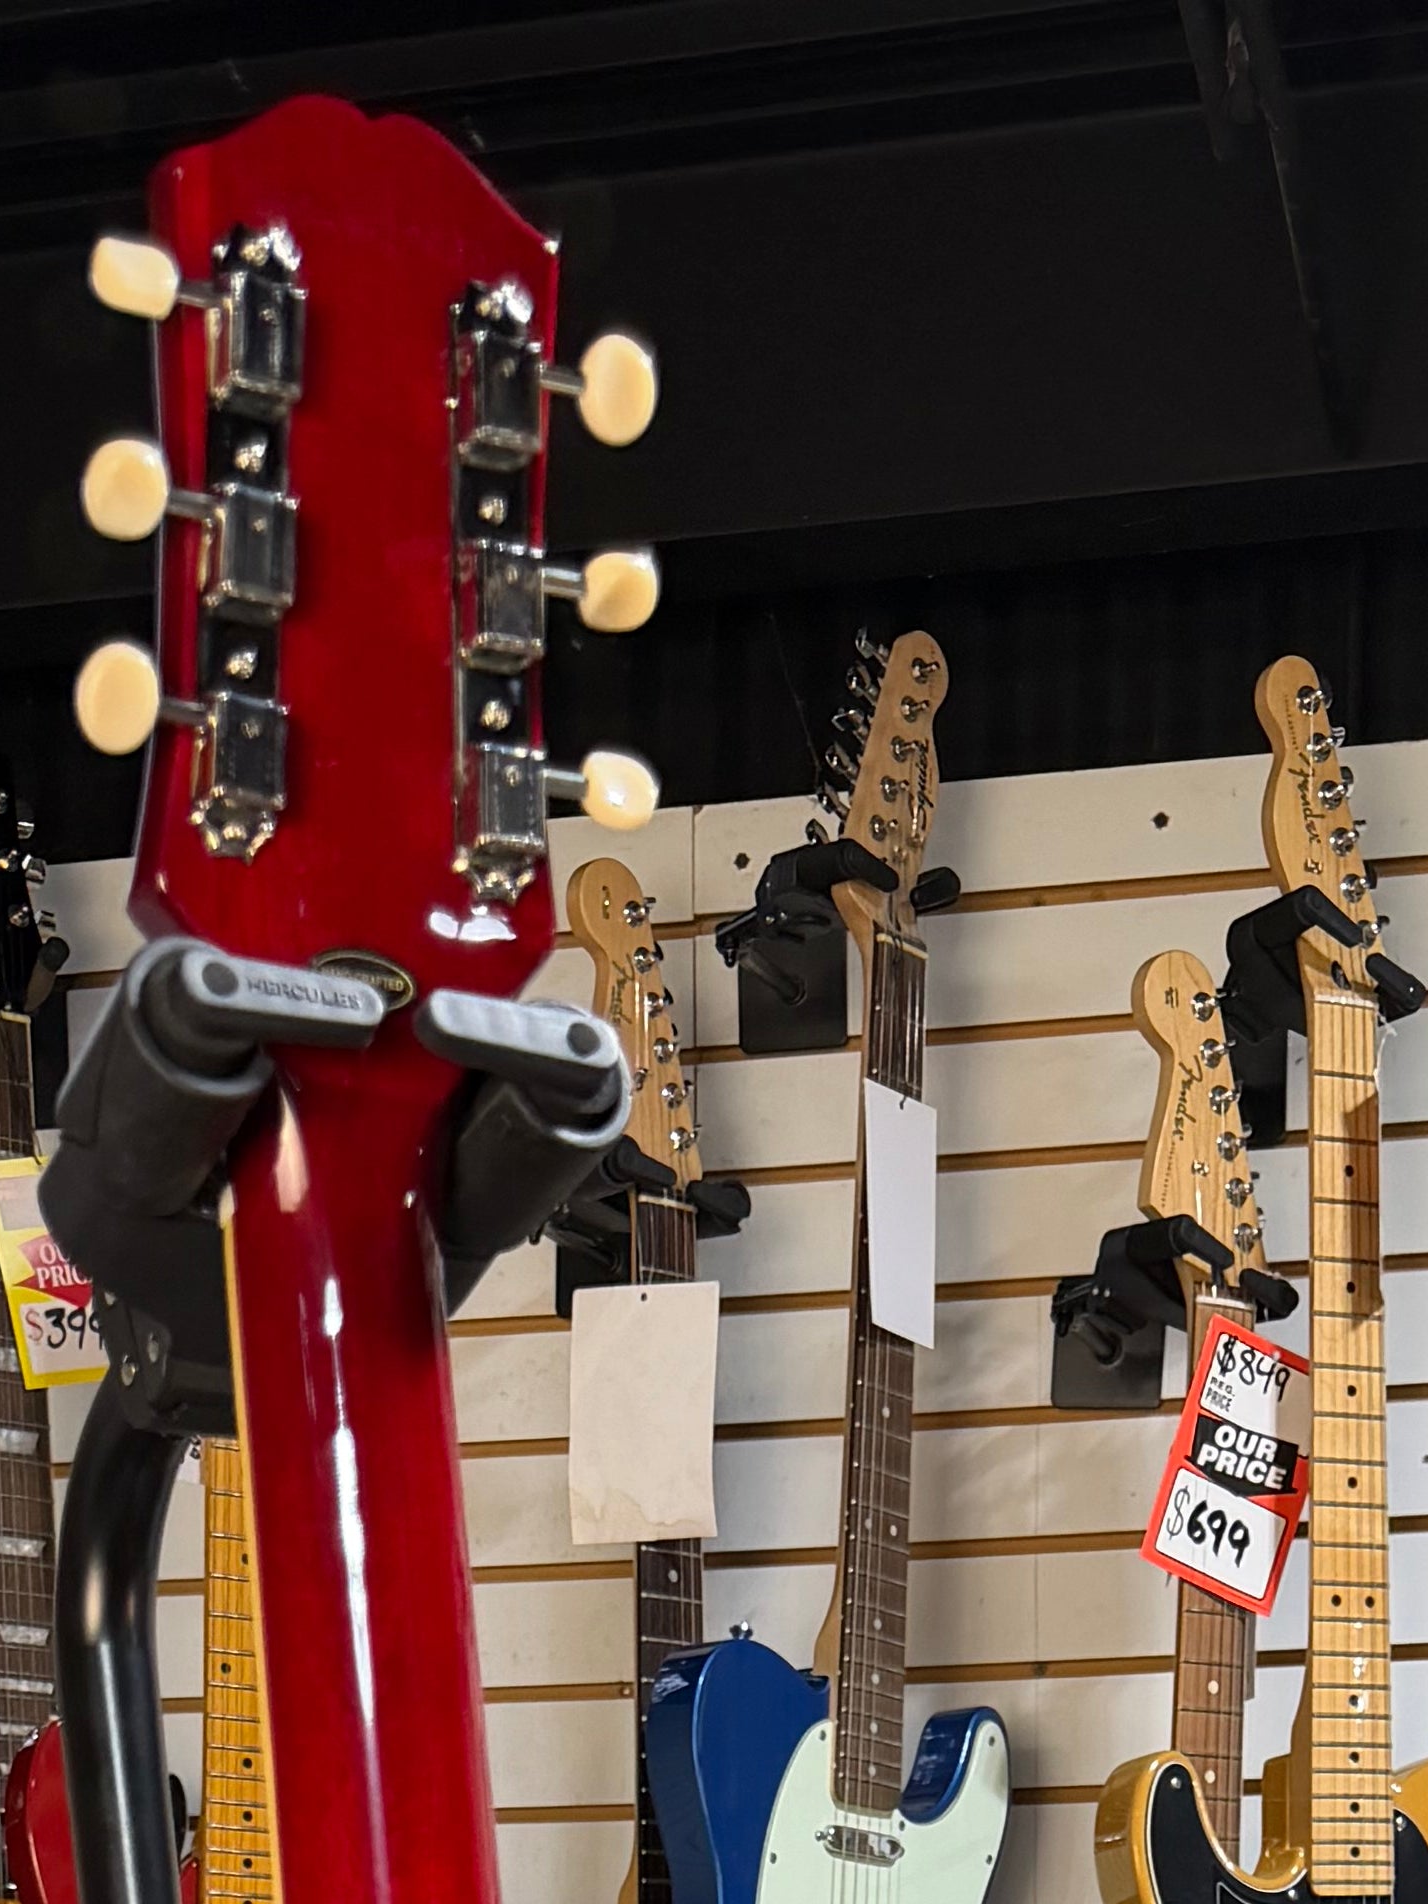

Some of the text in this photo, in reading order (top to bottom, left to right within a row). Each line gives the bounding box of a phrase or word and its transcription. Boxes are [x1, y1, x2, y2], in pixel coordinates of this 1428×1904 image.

[1287, 752, 1325, 845] Fender
[246, 977, 362, 1010] HERCULES
[1172, 1055, 1204, 1141] Fender
[36, 1263, 93, 1289] PRIC
[1217, 1336, 1290, 1402] $849
[1197, 1444, 1288, 1490] PRICE
[1214, 1425, 1278, 1462] OUR
[1167, 1485, 1250, 1568] $699
